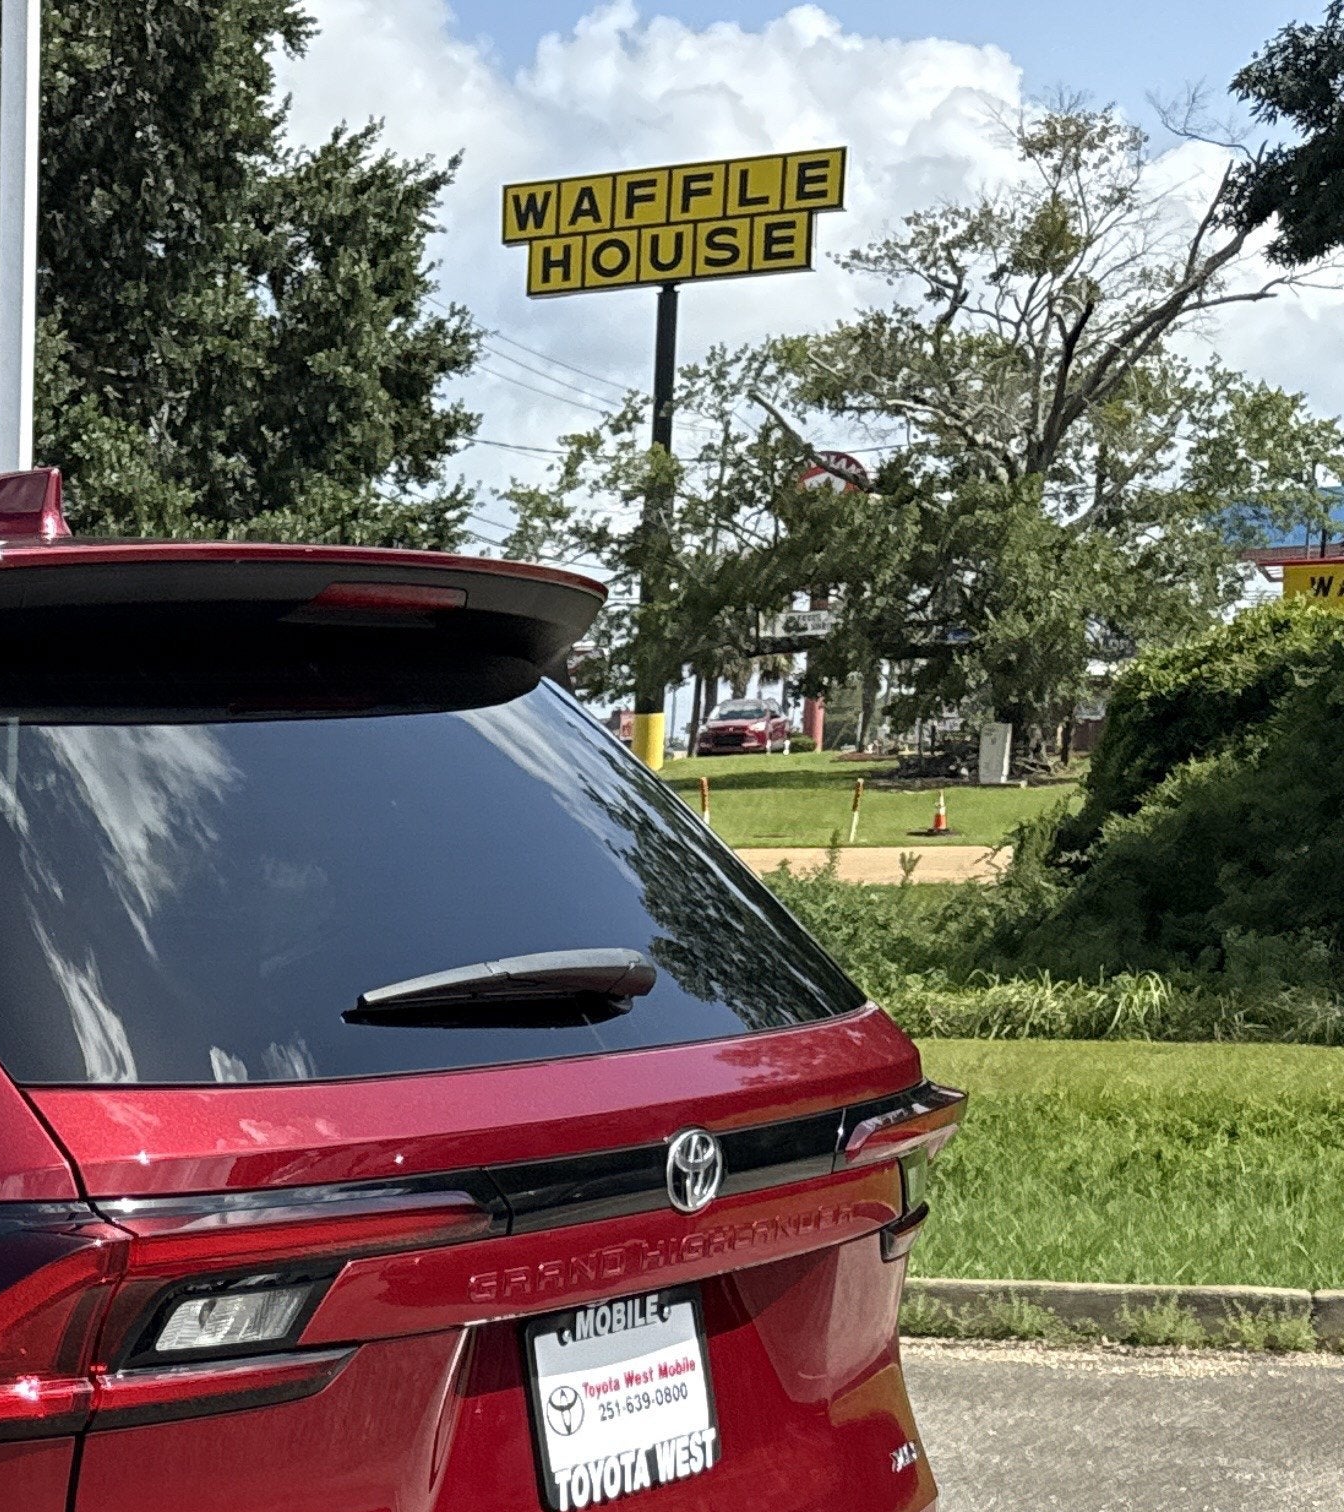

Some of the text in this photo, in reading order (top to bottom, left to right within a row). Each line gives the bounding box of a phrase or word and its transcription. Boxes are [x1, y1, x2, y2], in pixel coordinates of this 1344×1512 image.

[512, 159, 831, 231] WAFFLE
[541, 220, 798, 285] HOUSE
[468, 1204, 855, 1301] GRAND HIGHLANDER
[575, 1294, 660, 1341] MOBILE
[582, 1356, 696, 1400] Toyota West Mobile
[598, 1382, 689, 1422] 251-639-0800
[555, 1427, 716, 1512] TOYOTA WEST
